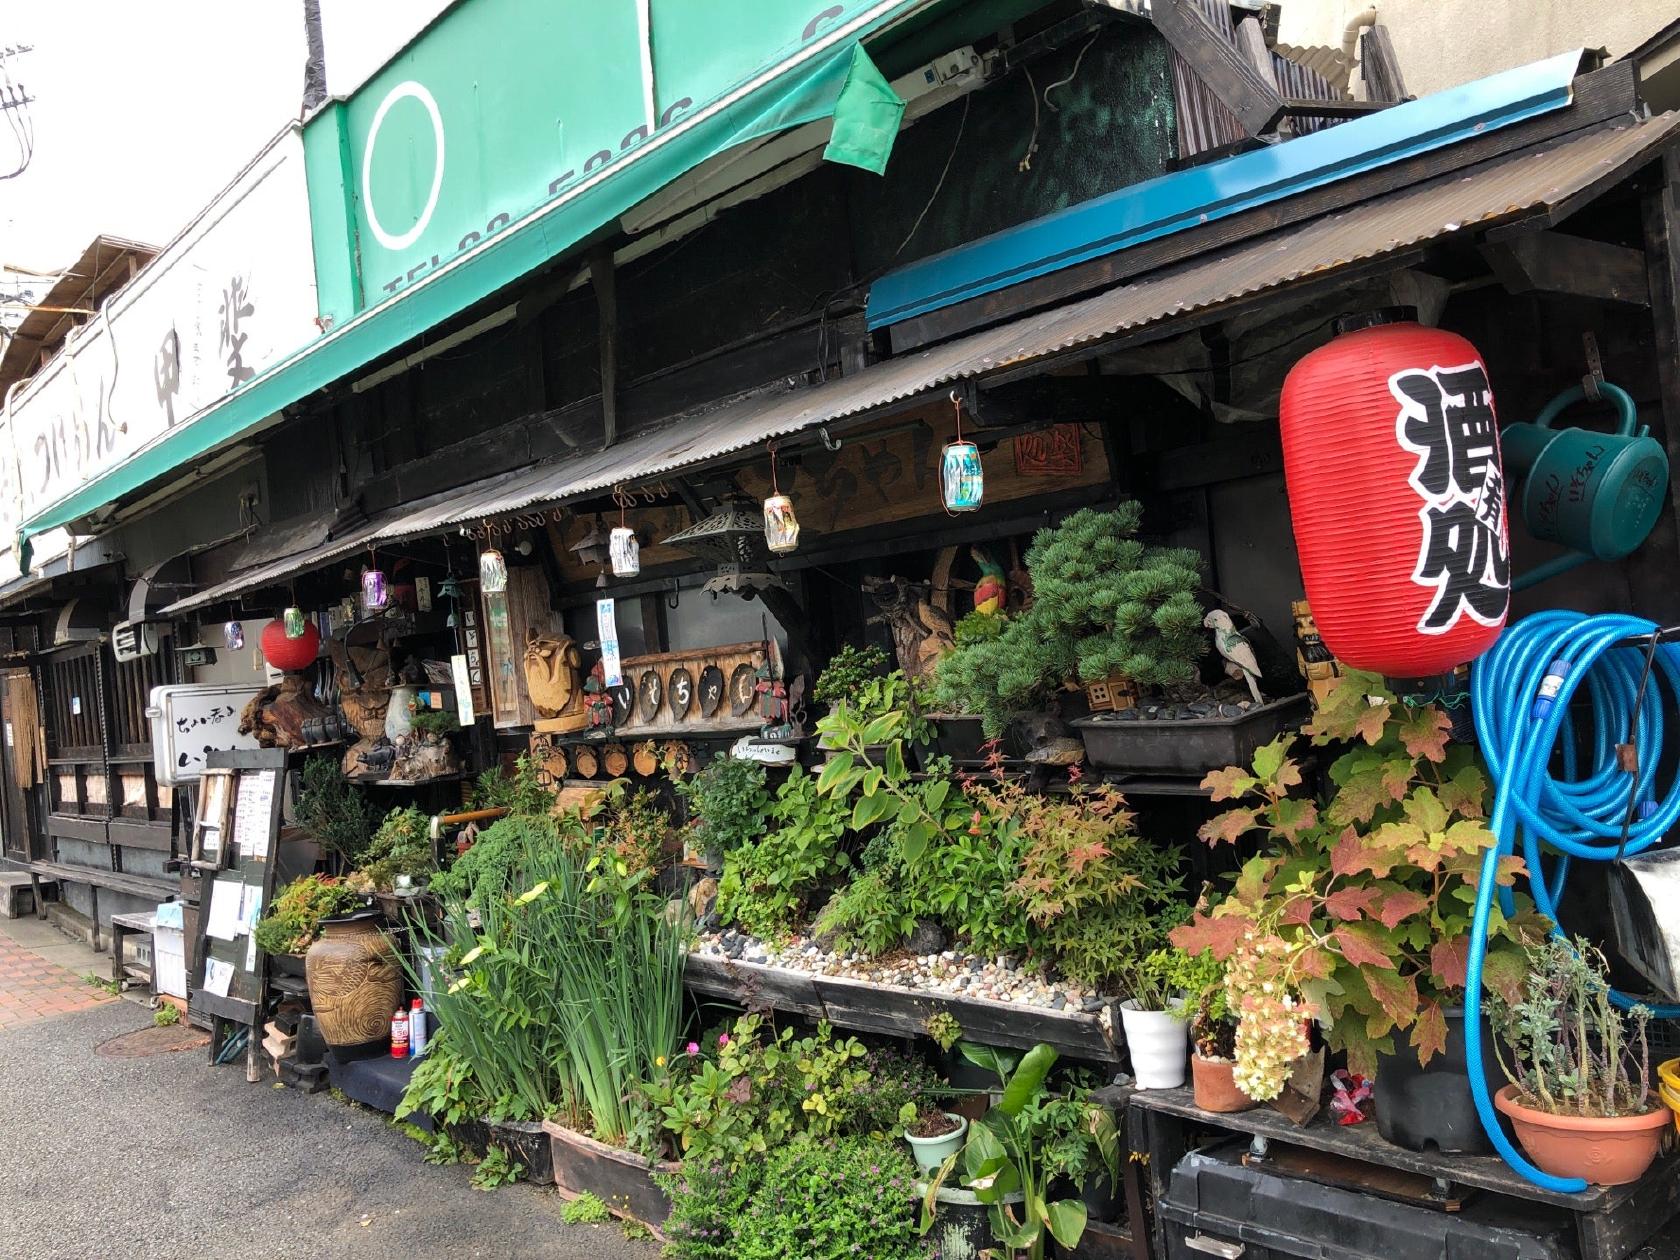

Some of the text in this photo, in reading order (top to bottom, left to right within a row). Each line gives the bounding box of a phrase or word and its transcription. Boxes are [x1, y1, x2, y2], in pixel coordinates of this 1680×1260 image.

[1390, 363, 1511, 632] 酒処
[617, 674, 753, 709] いそちゃん
